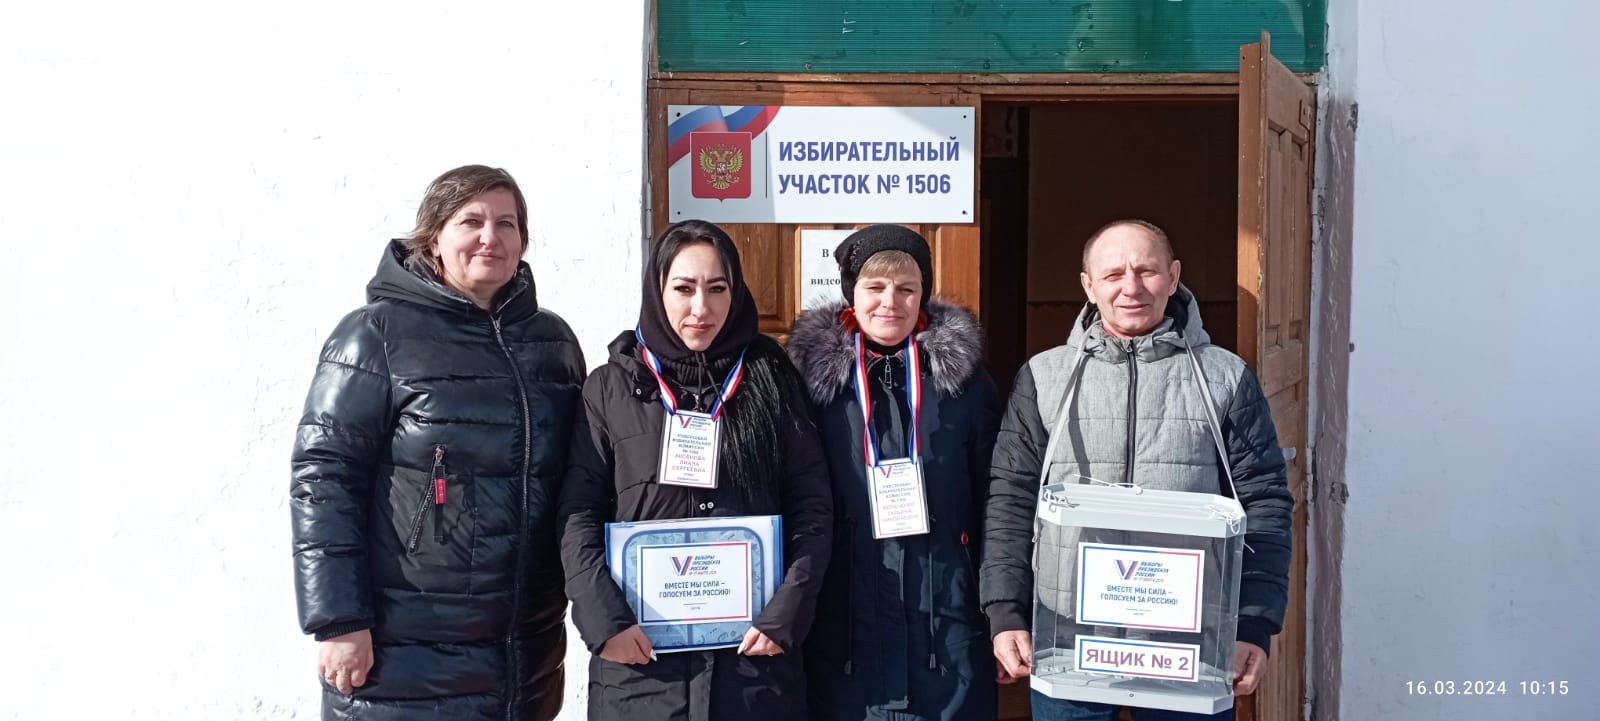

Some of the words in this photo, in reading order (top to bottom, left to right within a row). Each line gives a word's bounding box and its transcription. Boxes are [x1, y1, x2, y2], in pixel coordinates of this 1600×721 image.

[779, 136, 960, 162] ИЗБИРАТЕЛЬНЫЙ
[778, 174, 870, 194] УЧАСТОК
[877, 174, 900, 194] №
[906, 174, 951, 194] 1506
[810, 278, 841, 286] видео
[664, 581, 689, 590] ВМЕСТЕ
[703, 580, 720, 588] СИЛА
[1106, 584, 1133, 593] ВМЕСТЕ
[1135, 586, 1147, 594] МЫ
[1148, 588, 1167, 596] СИЛА
[659, 590, 692, 599] ГОЛОСУЕМ
[702, 588, 731, 596] РОССИЮ!
[1100, 593, 1136, 602] ГОЛОСУЕМ
[1137, 595, 1146, 603] ЗА
[1147, 596, 1178, 605] РОССИЮ!
[1086, 649, 1146, 667] ЯЩИК
[1151, 654, 1172, 669] №
[1178, 656, 1189, 671] 2
